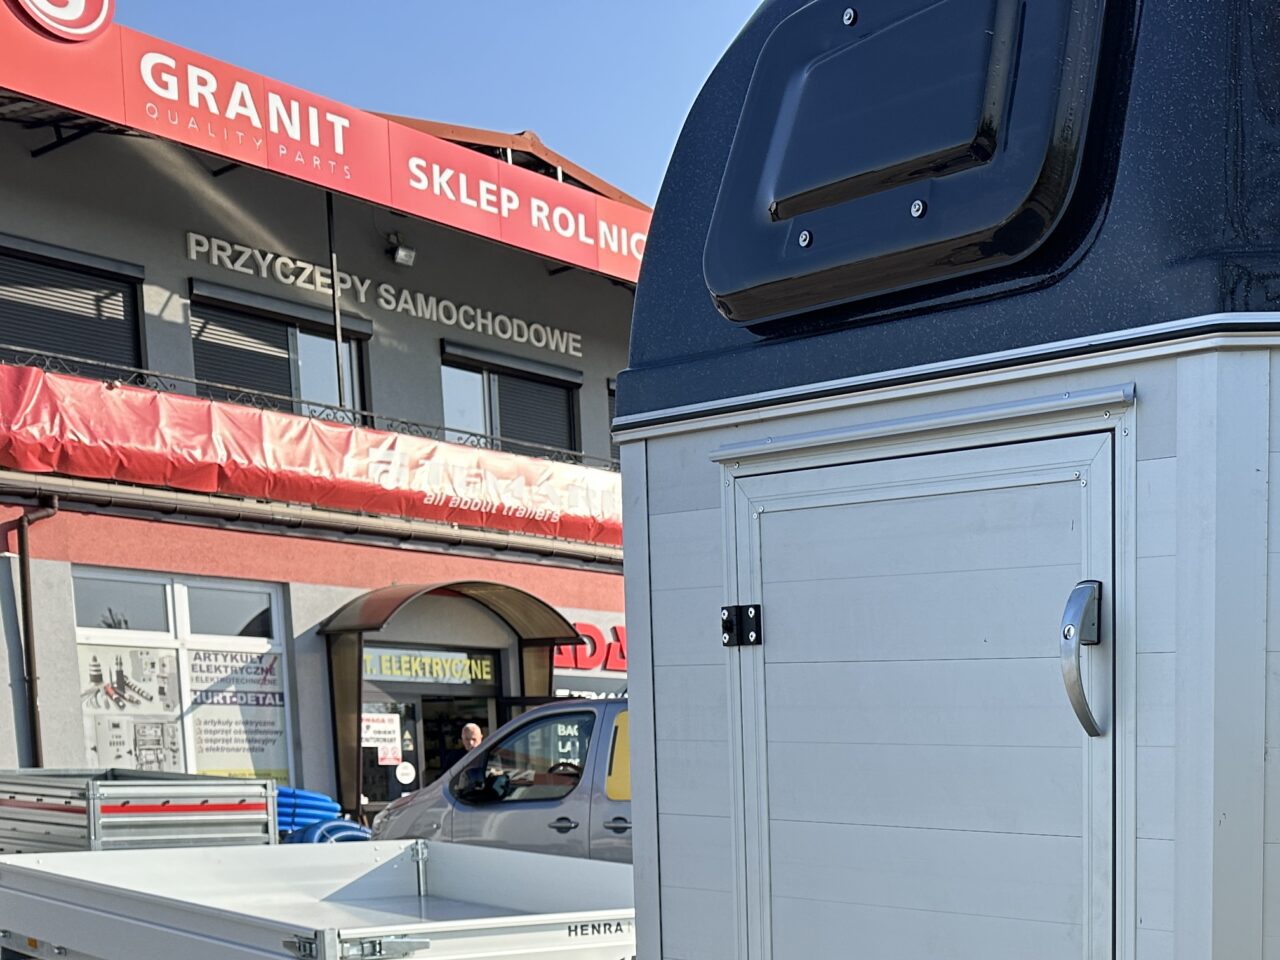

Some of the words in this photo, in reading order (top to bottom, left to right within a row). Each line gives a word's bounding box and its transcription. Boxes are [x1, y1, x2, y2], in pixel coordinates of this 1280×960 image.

[140, 52, 350, 155] GRANIT
[145, 102, 263, 150] QUALITY
[279, 144, 352, 179] PARTS
[408, 156, 520, 218] SKLEP
[186, 231, 371, 303] PRZYCZEPY
[377, 283, 583, 357] SAMOCHODOWE
[423, 490, 446, 506] all
[448, 495, 498, 514] about
[502, 502, 560, 523] trailers
[191, 664, 276, 676] ELEKTRYCZNE
[193, 652, 264, 664] ARTYKUŁY
[380, 655, 492, 680] ELEKTRYCZNE
[567, 921, 624, 937] HENRA
